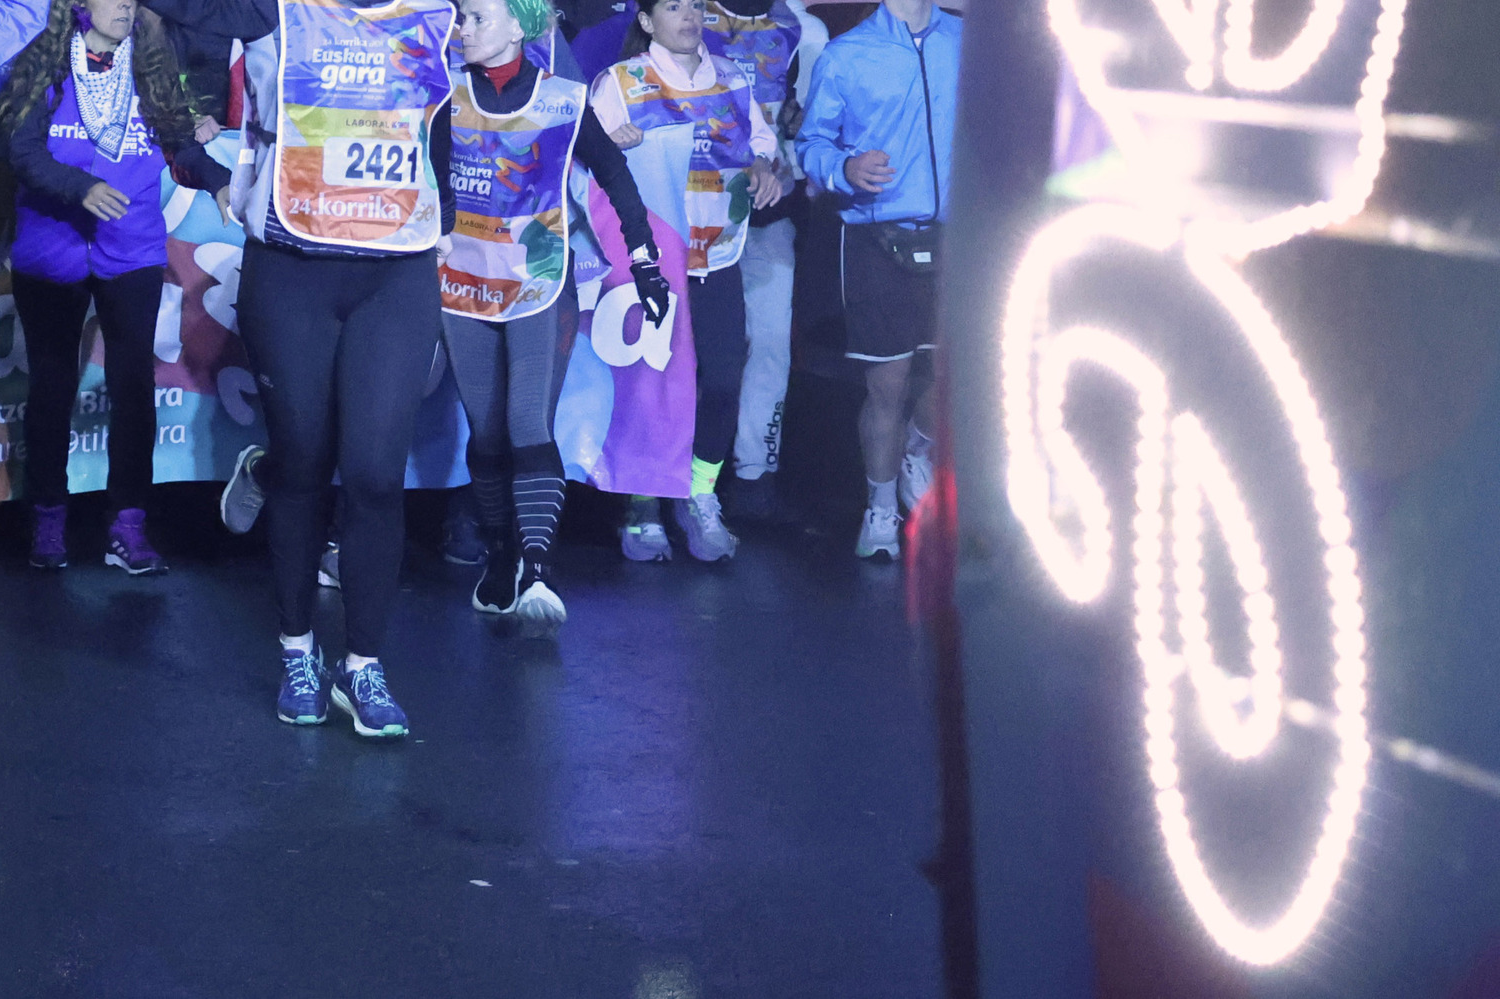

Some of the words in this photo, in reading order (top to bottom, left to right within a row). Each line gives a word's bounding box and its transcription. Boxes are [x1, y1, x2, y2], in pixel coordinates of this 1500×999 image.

[312, 48, 385, 65] Euskara
[320, 64, 386, 90] gara
[547, 103, 573, 115] eitb
[345, 119, 390, 130] LABORAL
[345, 142, 418, 183] 2421
[450, 162, 492, 179] uskara
[288, 192, 401, 220] 24.korrika
[441, 273, 504, 304] korrika
[764, 400, 784, 465] adidas
